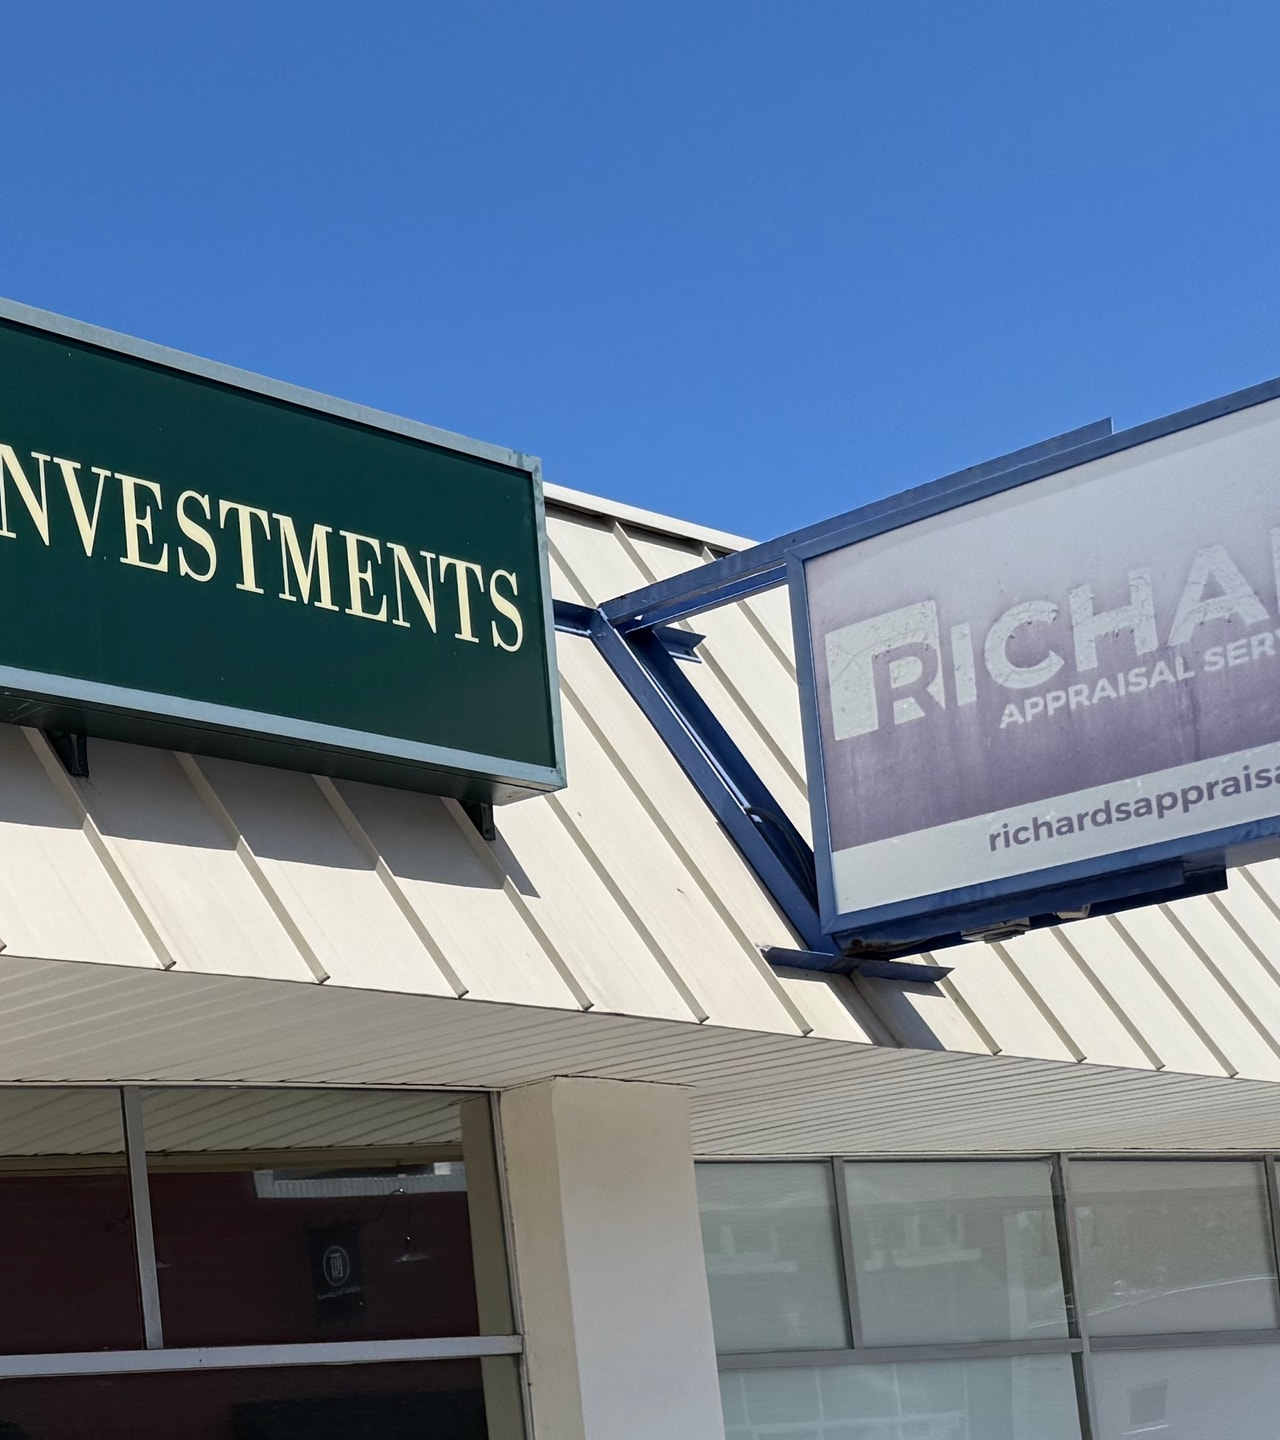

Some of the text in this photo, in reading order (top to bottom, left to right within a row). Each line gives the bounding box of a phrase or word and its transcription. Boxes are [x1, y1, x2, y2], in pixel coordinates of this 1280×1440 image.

[824, 527, 1280, 741] RICHA
[1000, 629, 1280, 729] APPRAISAL SER
